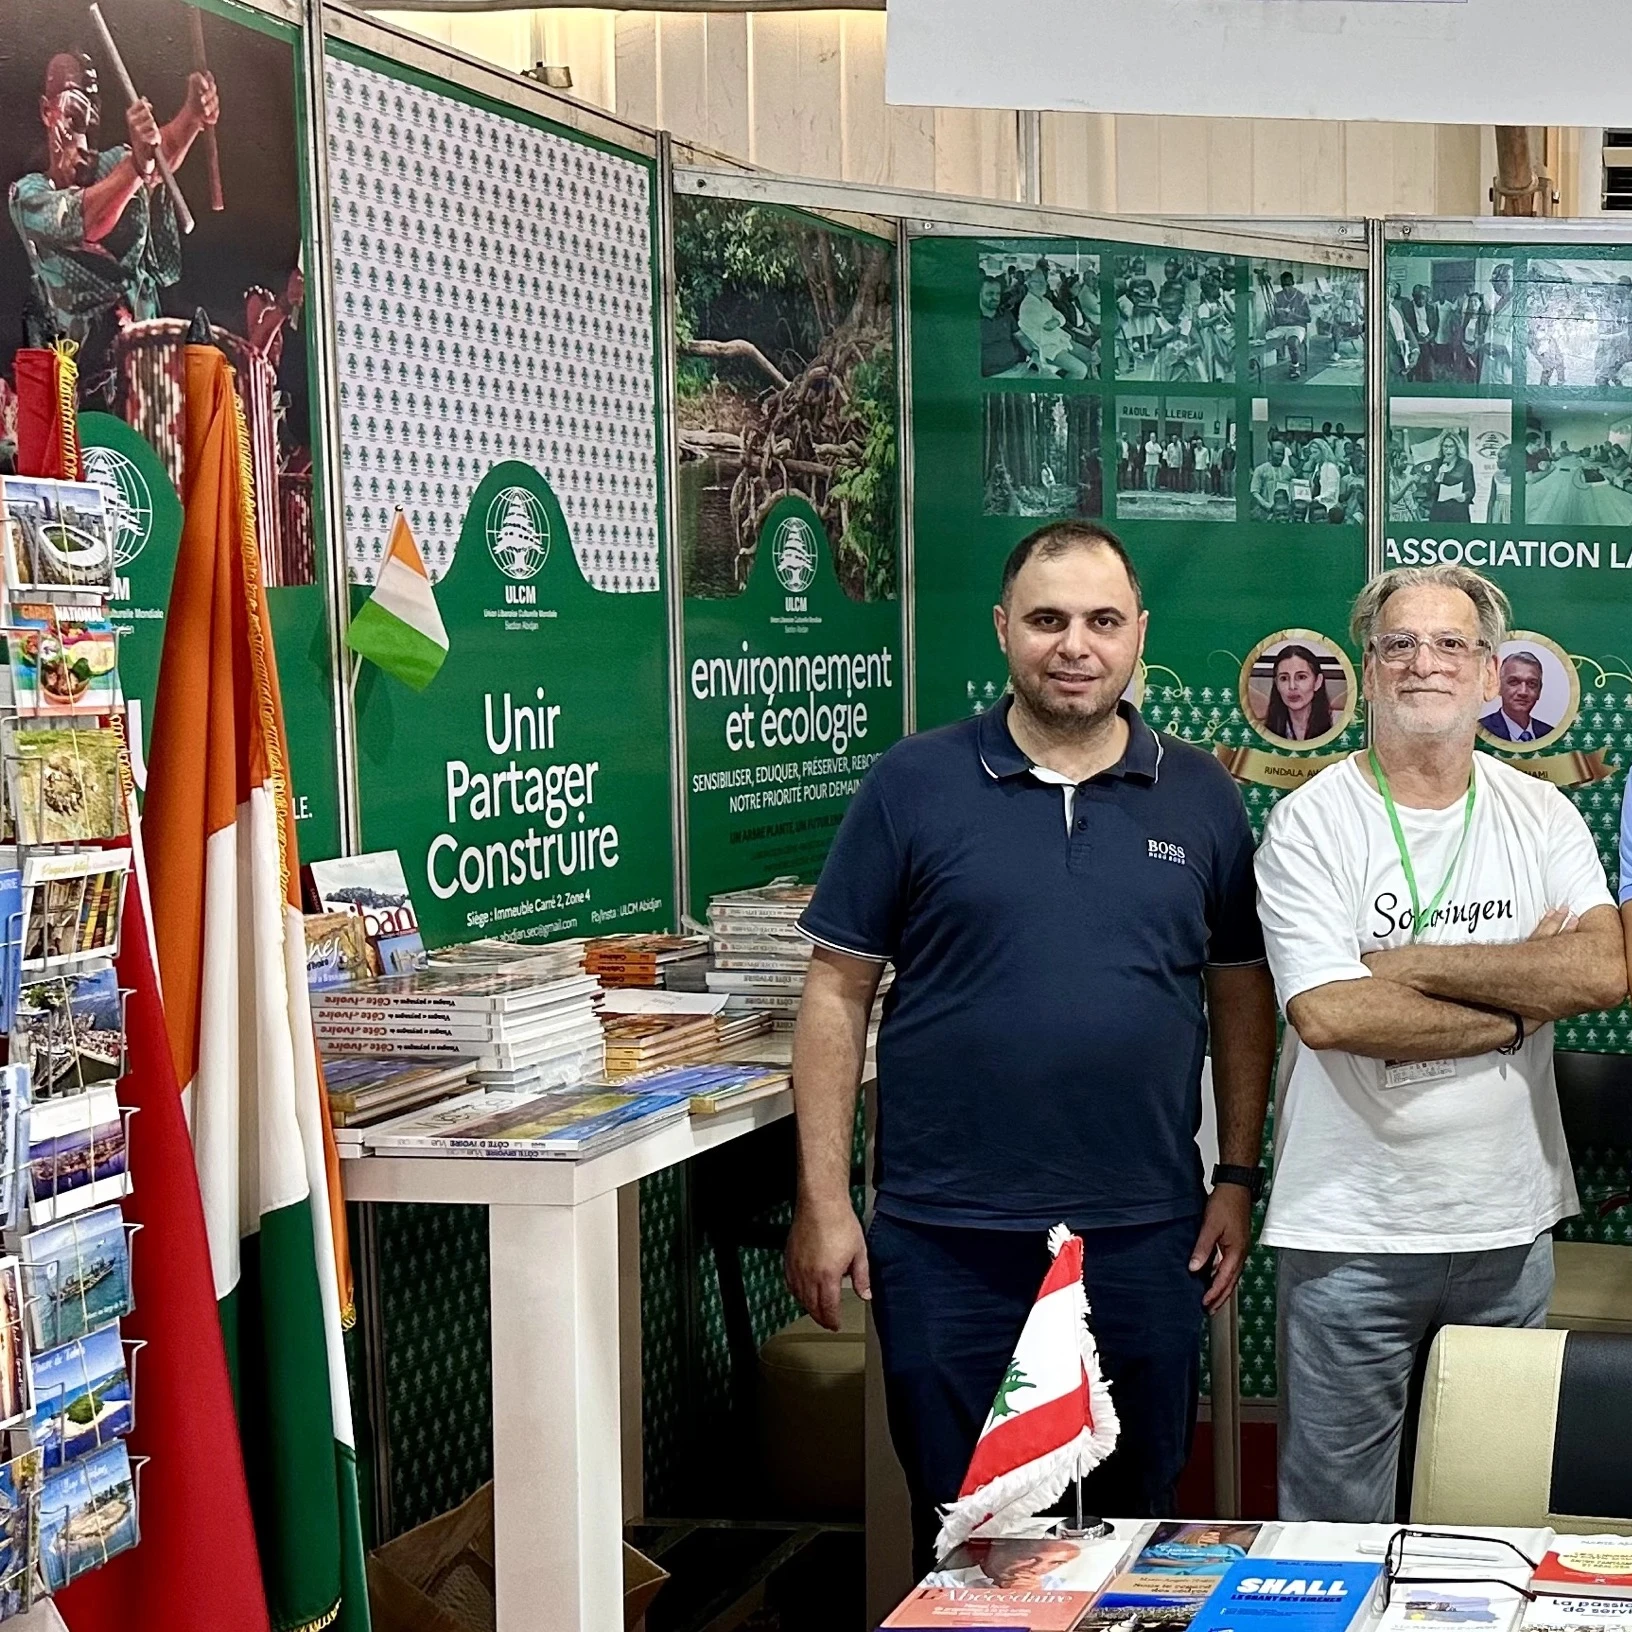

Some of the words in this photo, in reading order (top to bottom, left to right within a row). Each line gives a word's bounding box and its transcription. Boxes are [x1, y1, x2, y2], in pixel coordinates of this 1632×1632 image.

[1122, 406, 1150, 418] RAOUL
[1155, 407, 1204, 420] FLLEREAU
[1386, 538, 1600, 569] ASSOCIATION
[506, 585, 536, 604] ULCM
[785, 597, 807, 612] ULCM
[691, 641, 892, 700] environnement
[484, 687, 561, 755] Unir
[726, 703, 755, 751] et
[761, 691, 868, 754] écologie
[693, 770, 755, 793] SENSIBILISER,
[756, 764, 801, 784] EDUQUER,
[803, 756, 851, 777] PRÉSERVER,
[1264, 766, 1304, 778] RINDALA
[446, 761, 599, 829] Partager
[730, 793, 762, 813] NOTRE
[763, 783, 803, 807] PRIORITÉ
[804, 784, 828, 801] POUR
[427, 811, 619, 900] Construire
[1147, 839, 1186, 859] BOSS
[466, 911, 490, 929] Siège
[494, 901, 534, 921] Immeuble
[534, 896, 556, 914] Carré
[557, 894, 565, 908] 2,
[565, 892, 584, 906] Zone
[584, 888, 591, 901] 4
[367, 997, 391, 1007] Côte
[361, 1012, 386, 1021] Côte
[363, 1027, 387, 1036] Côte
[370, 1043, 394, 1052] Côte
[1236, 1577, 1349, 1596] SHALL
